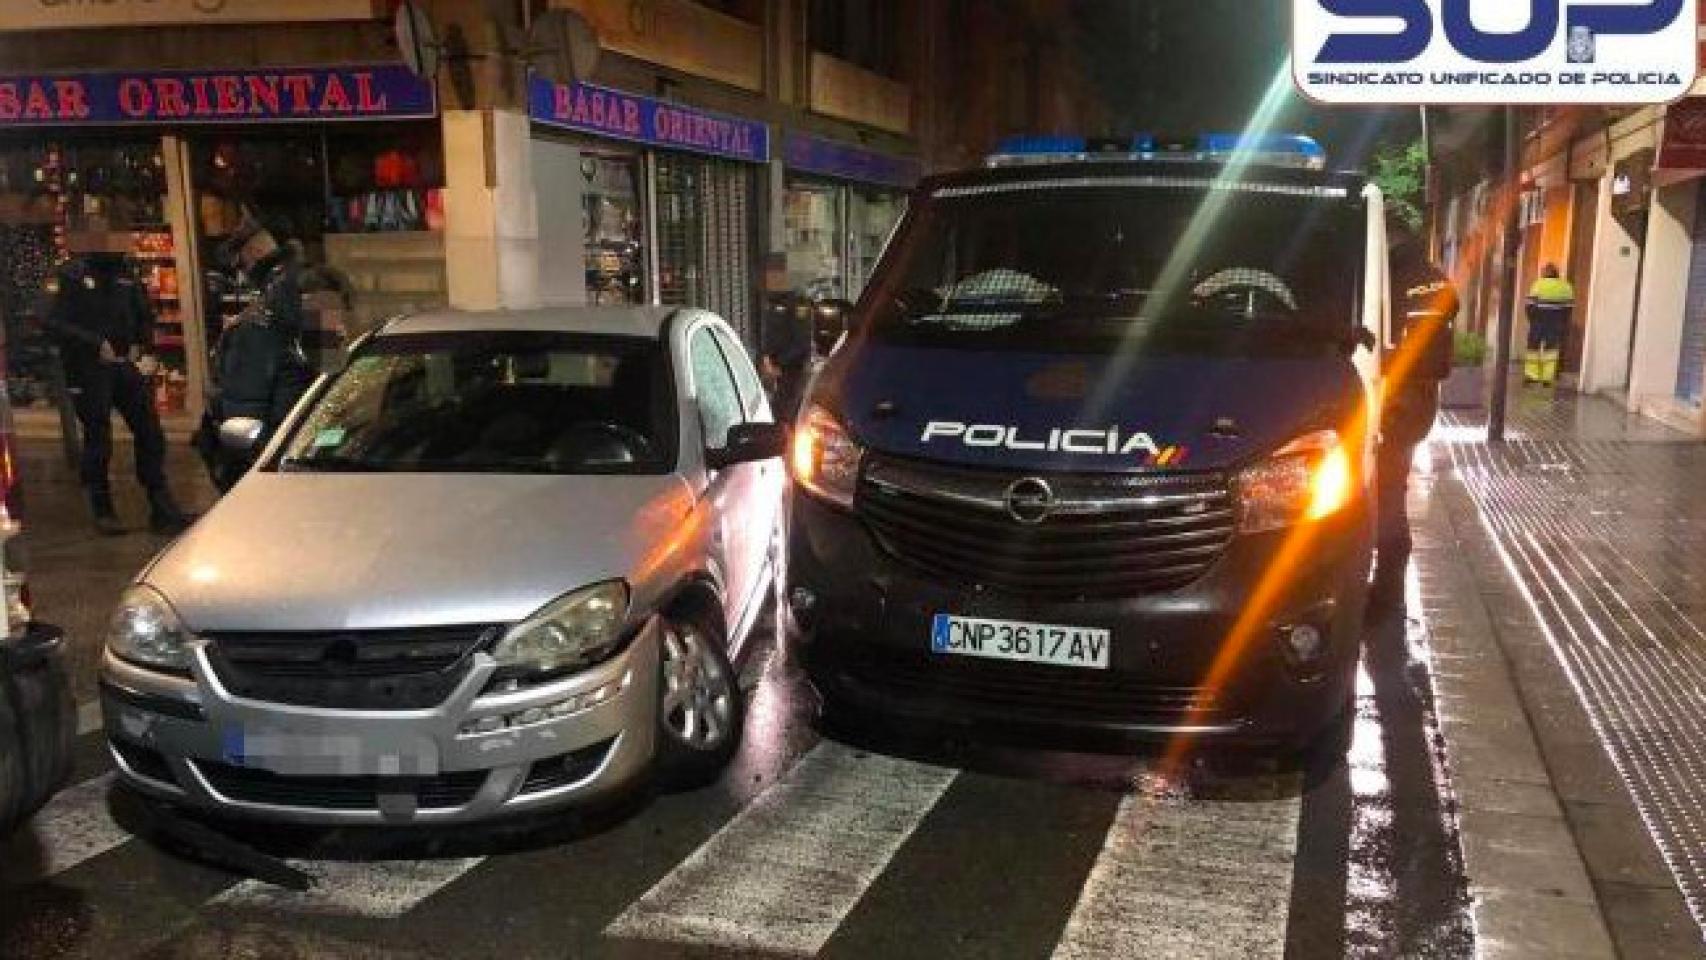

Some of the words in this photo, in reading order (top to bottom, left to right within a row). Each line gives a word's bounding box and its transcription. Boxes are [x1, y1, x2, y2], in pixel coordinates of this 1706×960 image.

[117, 72, 387, 118] ORIENTAL
[655, 104, 753, 153] ORIENTAL
[949, 620, 1106, 663] CNP3617AV
